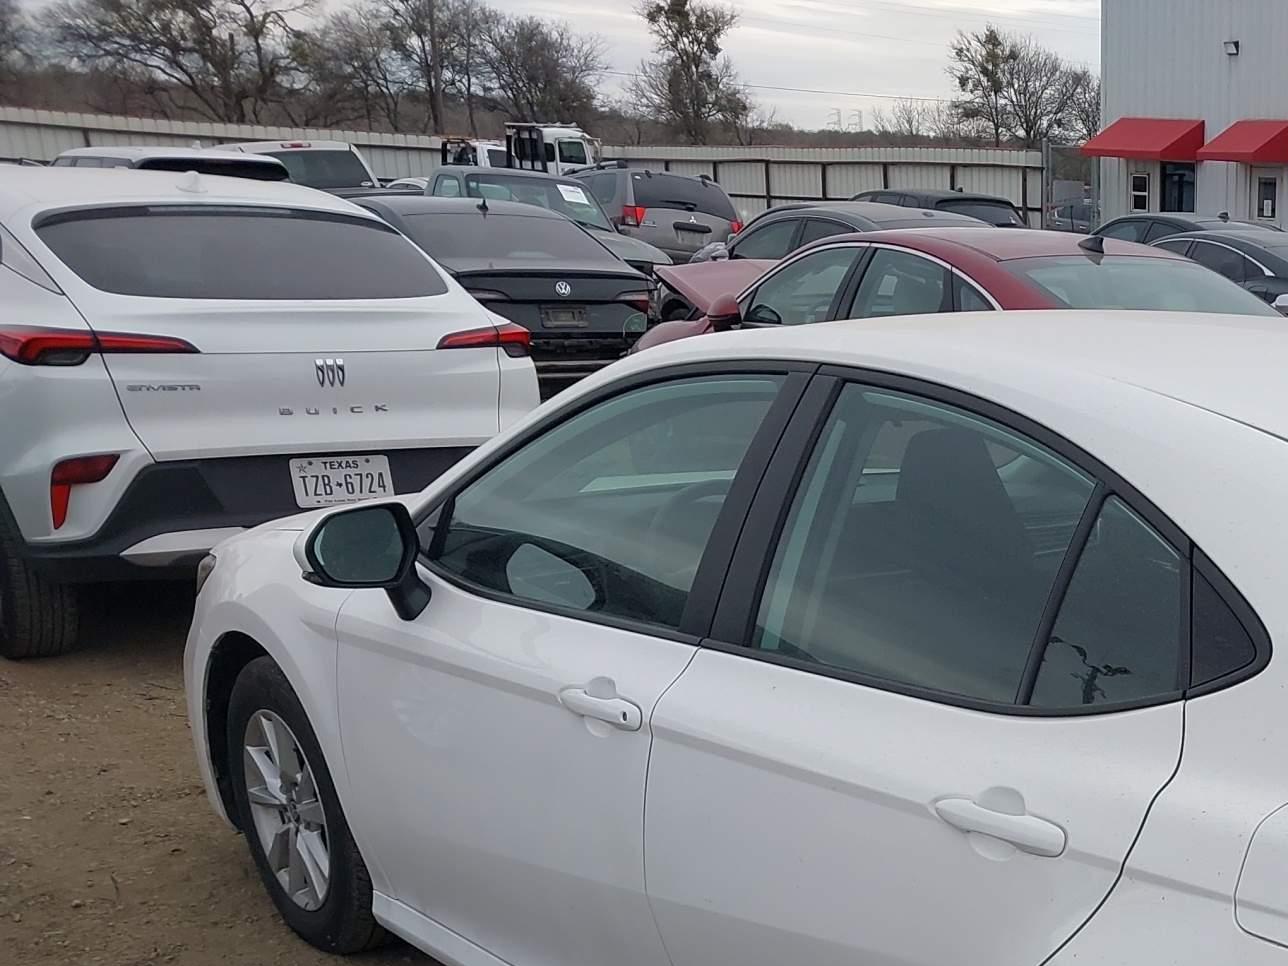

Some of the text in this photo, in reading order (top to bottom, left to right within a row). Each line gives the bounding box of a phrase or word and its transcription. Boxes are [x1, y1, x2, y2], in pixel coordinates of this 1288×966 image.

[126, 384, 201, 393] ENVISTA
[279, 404, 389, 416] BUICK
[321, 460, 359, 471] TEXAS
